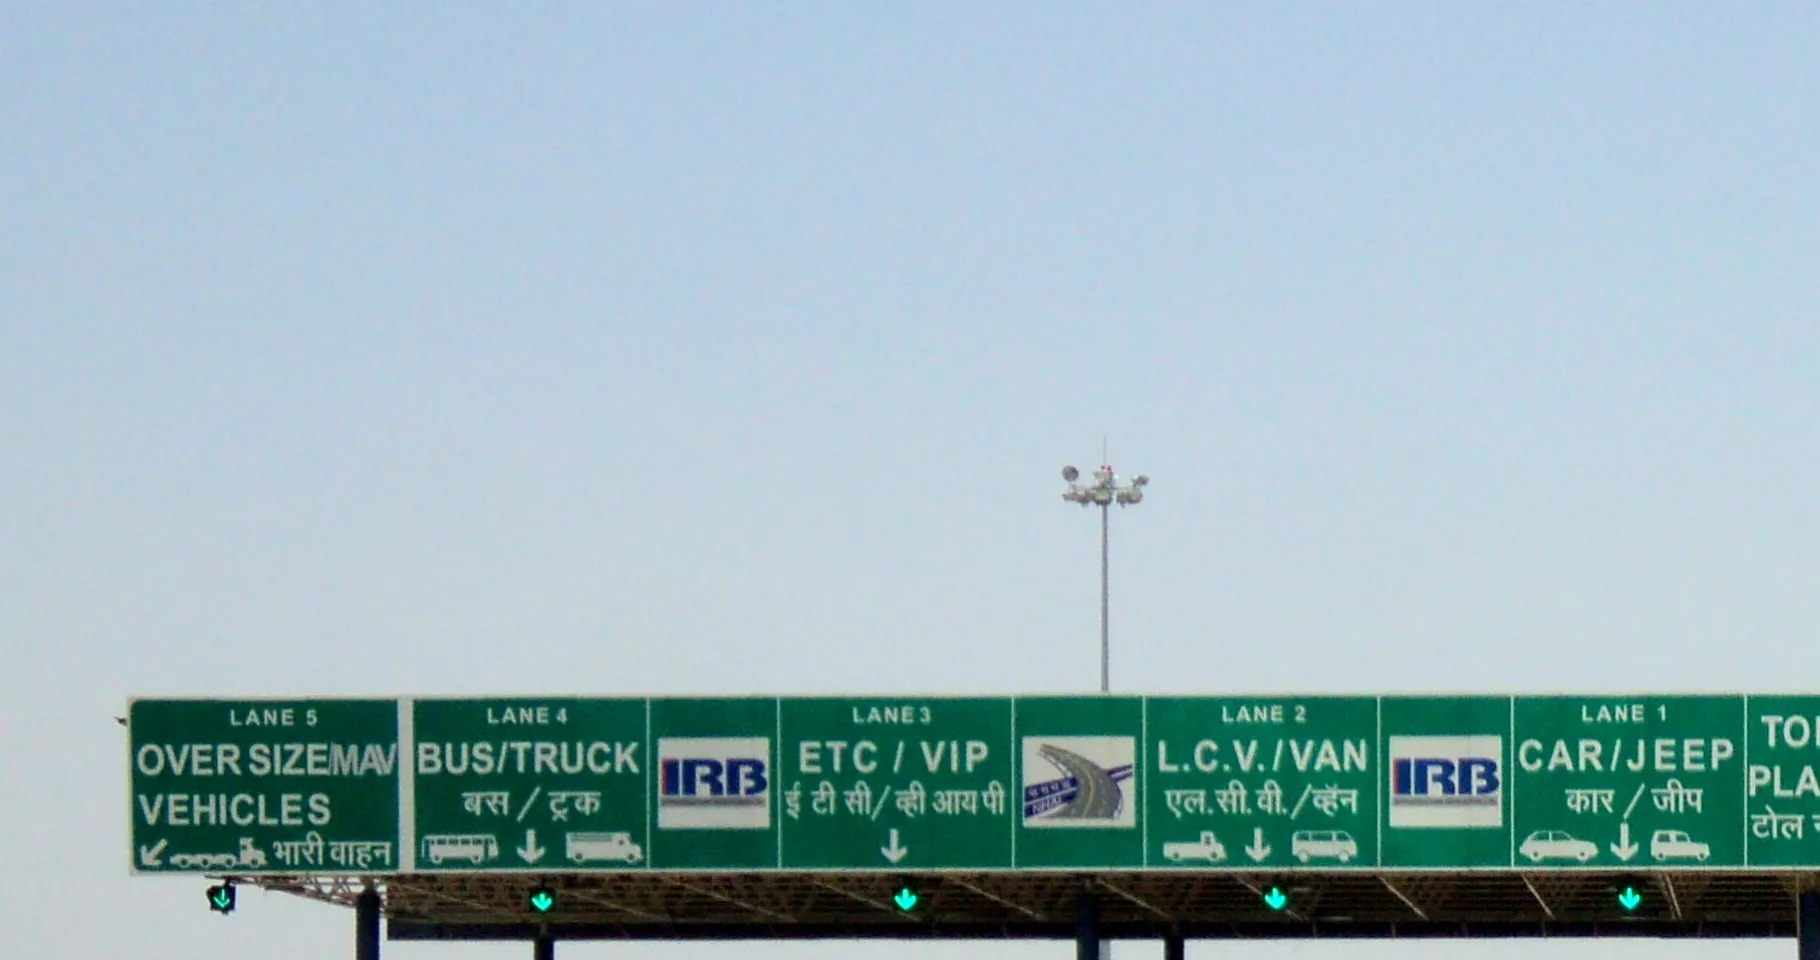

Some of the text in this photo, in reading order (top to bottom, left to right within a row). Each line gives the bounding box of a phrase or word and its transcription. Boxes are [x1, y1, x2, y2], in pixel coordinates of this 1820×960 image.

[230, 709, 318, 726] LANE 5
[487, 707, 567, 724] LANE 4
[852, 706, 931, 724] LANE 3
[1221, 705, 1306, 723] LANE 2
[1581, 704, 1666, 722] LANE 1
[138, 744, 241, 776] OVER
[418, 741, 639, 774] BUS/TRUCK
[800, 741, 877, 773] ETC
[921, 741, 988, 773] VIP
[1158, 739, 1367, 772] L.C.V./VAN
[1519, 738, 1734, 772] CAR/JEEP
[661, 758, 768, 796] IRB
[1392, 758, 1499, 795] IRB
[139, 793, 331, 825] VEHICLES
[461, 791, 509, 816] बस
[1565, 789, 1615, 814] कार
[1651, 778, 1703, 814] जीप
[1751, 804, 1805, 840] टोल
[273, 831, 392, 868] भारी वाहन
